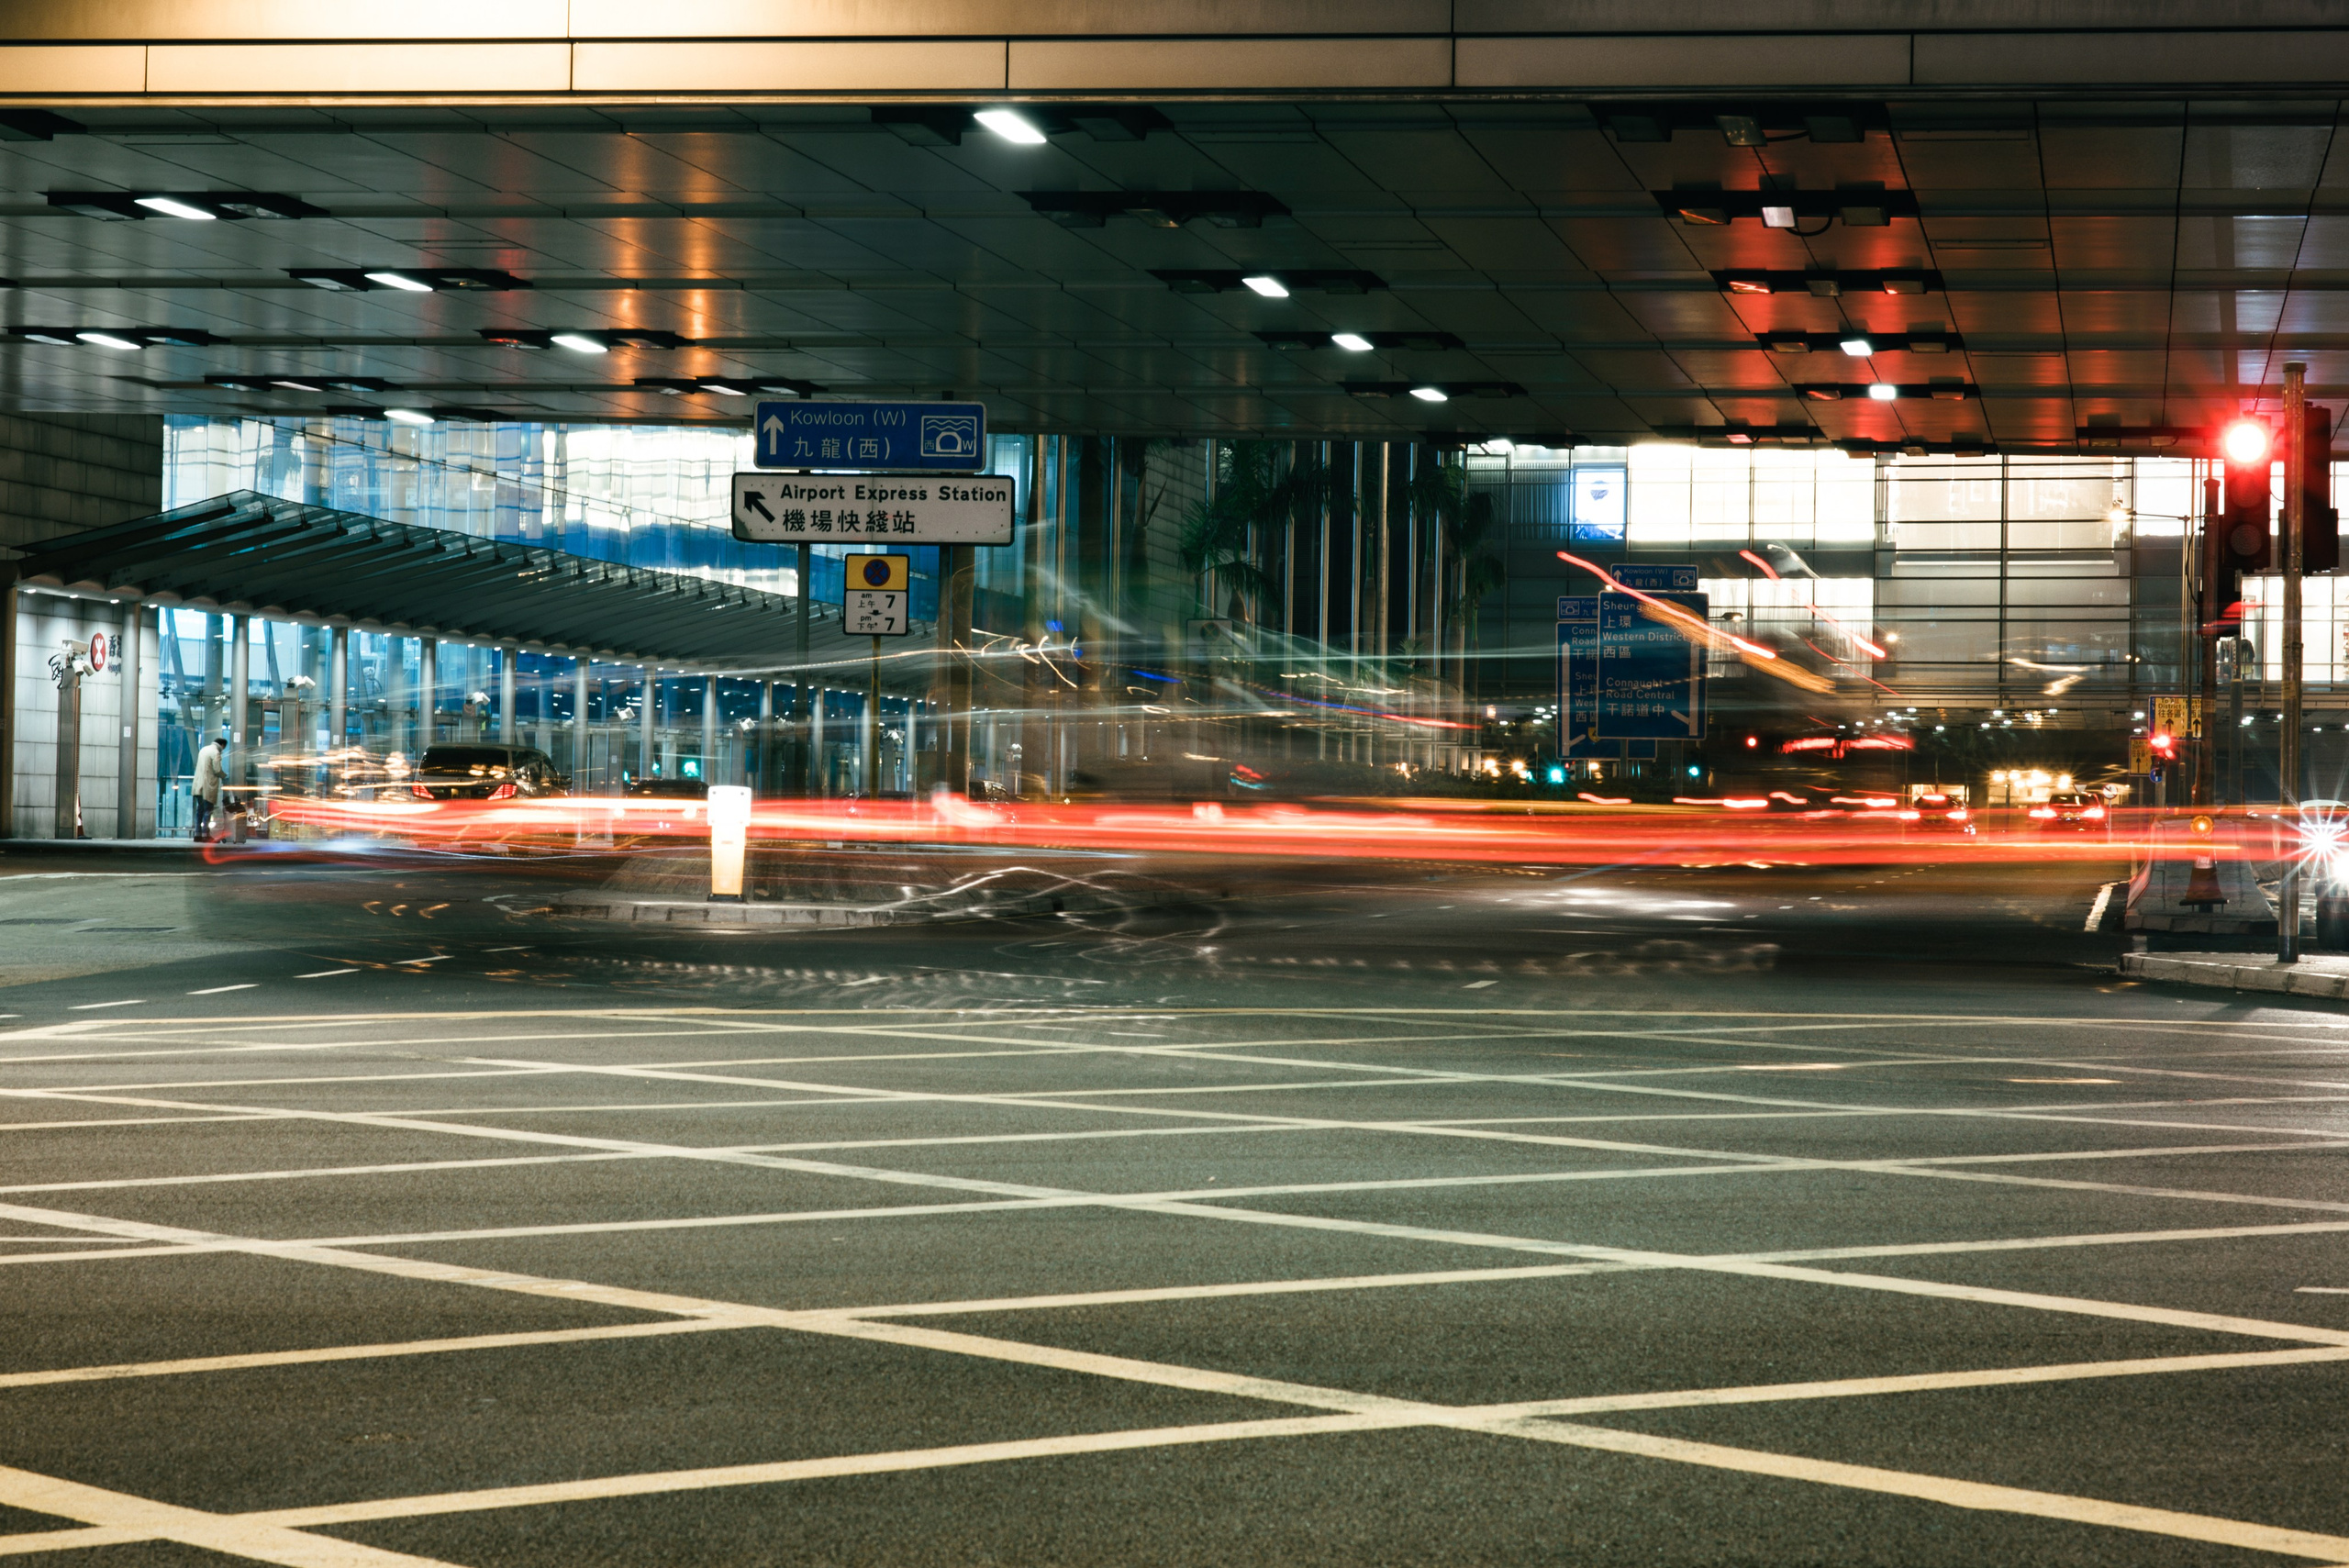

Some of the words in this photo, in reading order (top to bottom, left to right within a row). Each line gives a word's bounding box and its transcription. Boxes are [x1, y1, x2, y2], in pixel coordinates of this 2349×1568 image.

[790, 409, 864, 426] Kowloon
[874, 408, 907, 427] (W)
[794, 436, 891, 460] 九龍(西)
[924, 439, 935, 450] 西
[963, 439, 974, 450] W
[780, 484, 846, 503] Airport
[855, 484, 928, 503] Express
[938, 485, 1007, 502] Station
[782, 508, 916, 534] 機場快綫站
[857, 599, 875, 608] 上午
[885, 595, 896, 608] 7
[1603, 601, 1642, 613] Sheung
[857, 622, 875, 631] 下午
[885, 617, 895, 631] 7
[1571, 626, 1598, 635] Conn
[1602, 631, 1645, 641] Western
[1648, 631, 1687, 641] District
[1571, 637, 1597, 646] Road
[1603, 645, 1631, 659] 西區
[1606, 677, 1664, 689] Connaught
[1606, 689, 1633, 699] Road
[1636, 689, 1675, 700] Central
